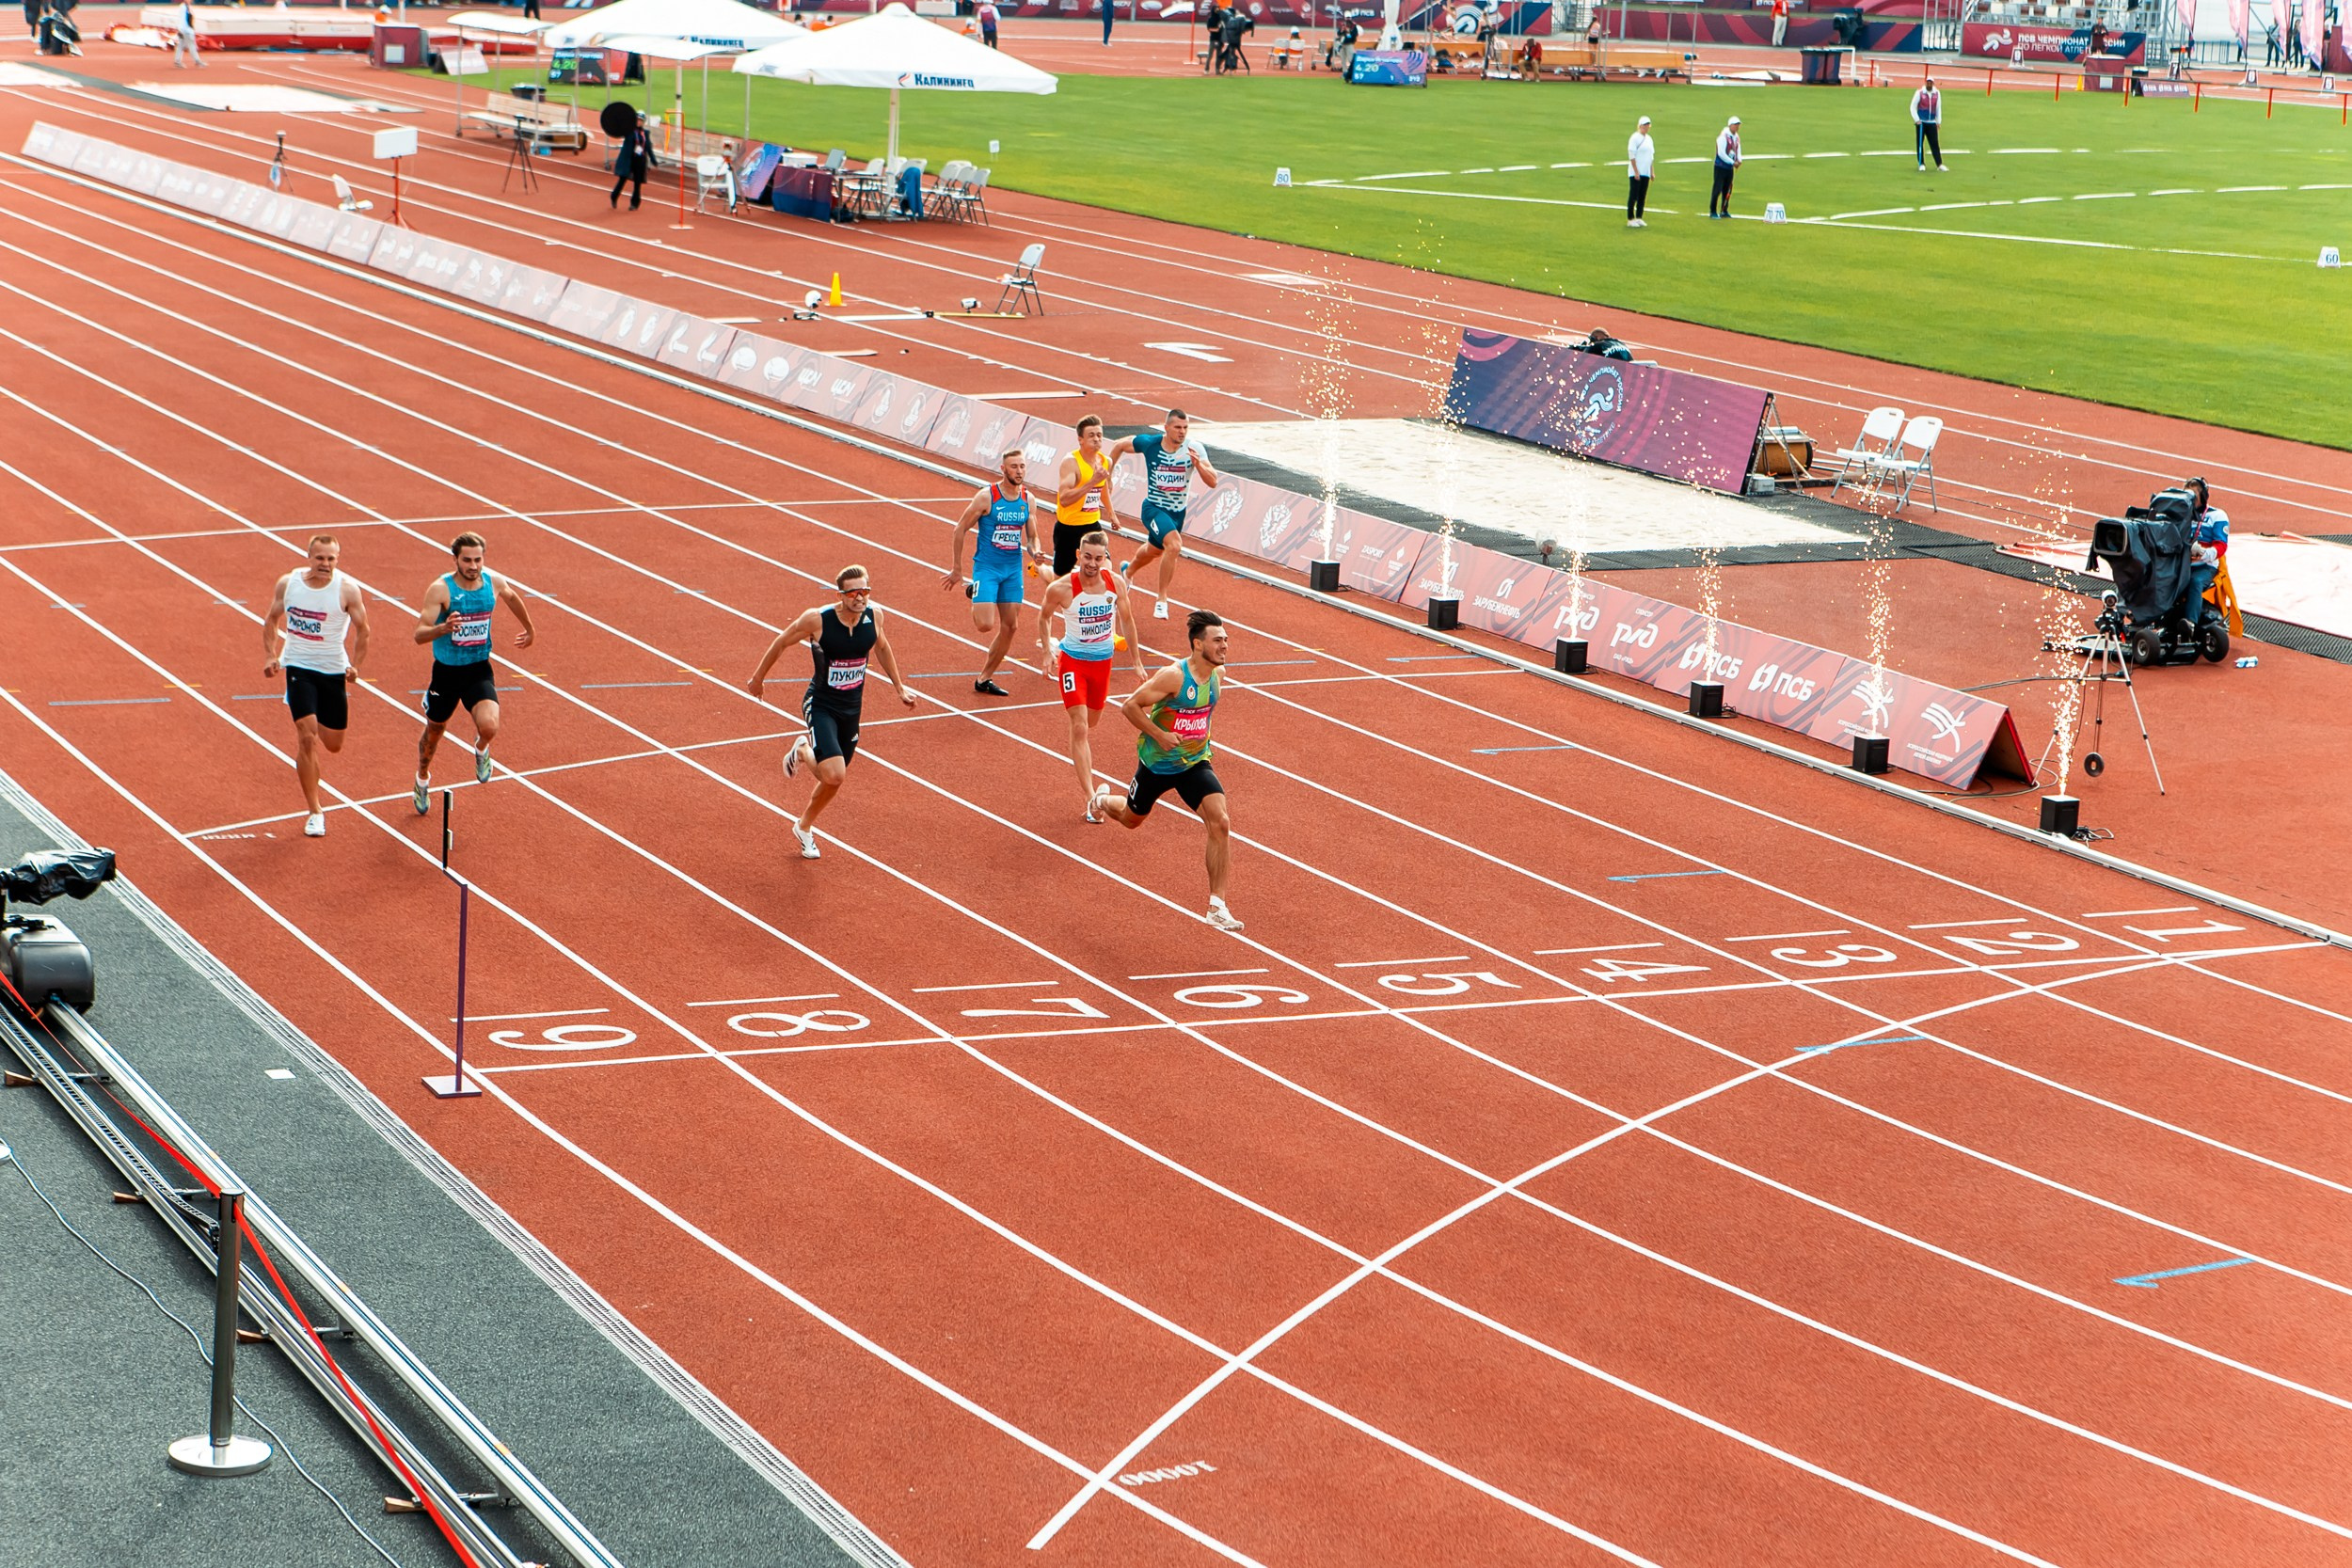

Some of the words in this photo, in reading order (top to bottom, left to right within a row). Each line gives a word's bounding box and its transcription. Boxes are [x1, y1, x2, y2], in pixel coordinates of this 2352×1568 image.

[2031, 43, 2062, 54] ЛЕГКОЙ
[2038, 35, 2089, 46] ЧЕМПИОНАТ
[1277, 173, 1289, 182] 80
[1774, 210, 1785, 219] 70
[2326, 254, 2339, 263] 60
[1157, 474, 1184, 483] КУДИН
[997, 512, 1025, 522] RUSSIA
[1360, 545, 1385, 558] ZASPORT
[1419, 578, 1465, 601] ЗАРУБЕНЕФТЬ
[1079, 605, 1112, 617] RUSSIA
[1472, 594, 1521, 619] ЗАРУБЕЖНЕФТЬ
[1610, 622, 1659, 649] РЖД
[1064, 673, 1073, 690] 5
[1773, 671, 1816, 702] ПСБ
[1173, 717, 1206, 731] КРЫЛОВ
[2122, 919, 2247, 942] 1
[1943, 931, 2080, 956] 2
[1770, 943, 1897, 968] 3
[1580, 958, 1710, 982] 4
[1377, 972, 1522, 995] 5
[961, 997, 1110, 1018] 7
[1173, 984, 1310, 1008] 6
[726, 1009, 871, 1037] 8
[488, 1024, 637, 1051] 9
[1119, 1460, 1218, 1486] 10000
